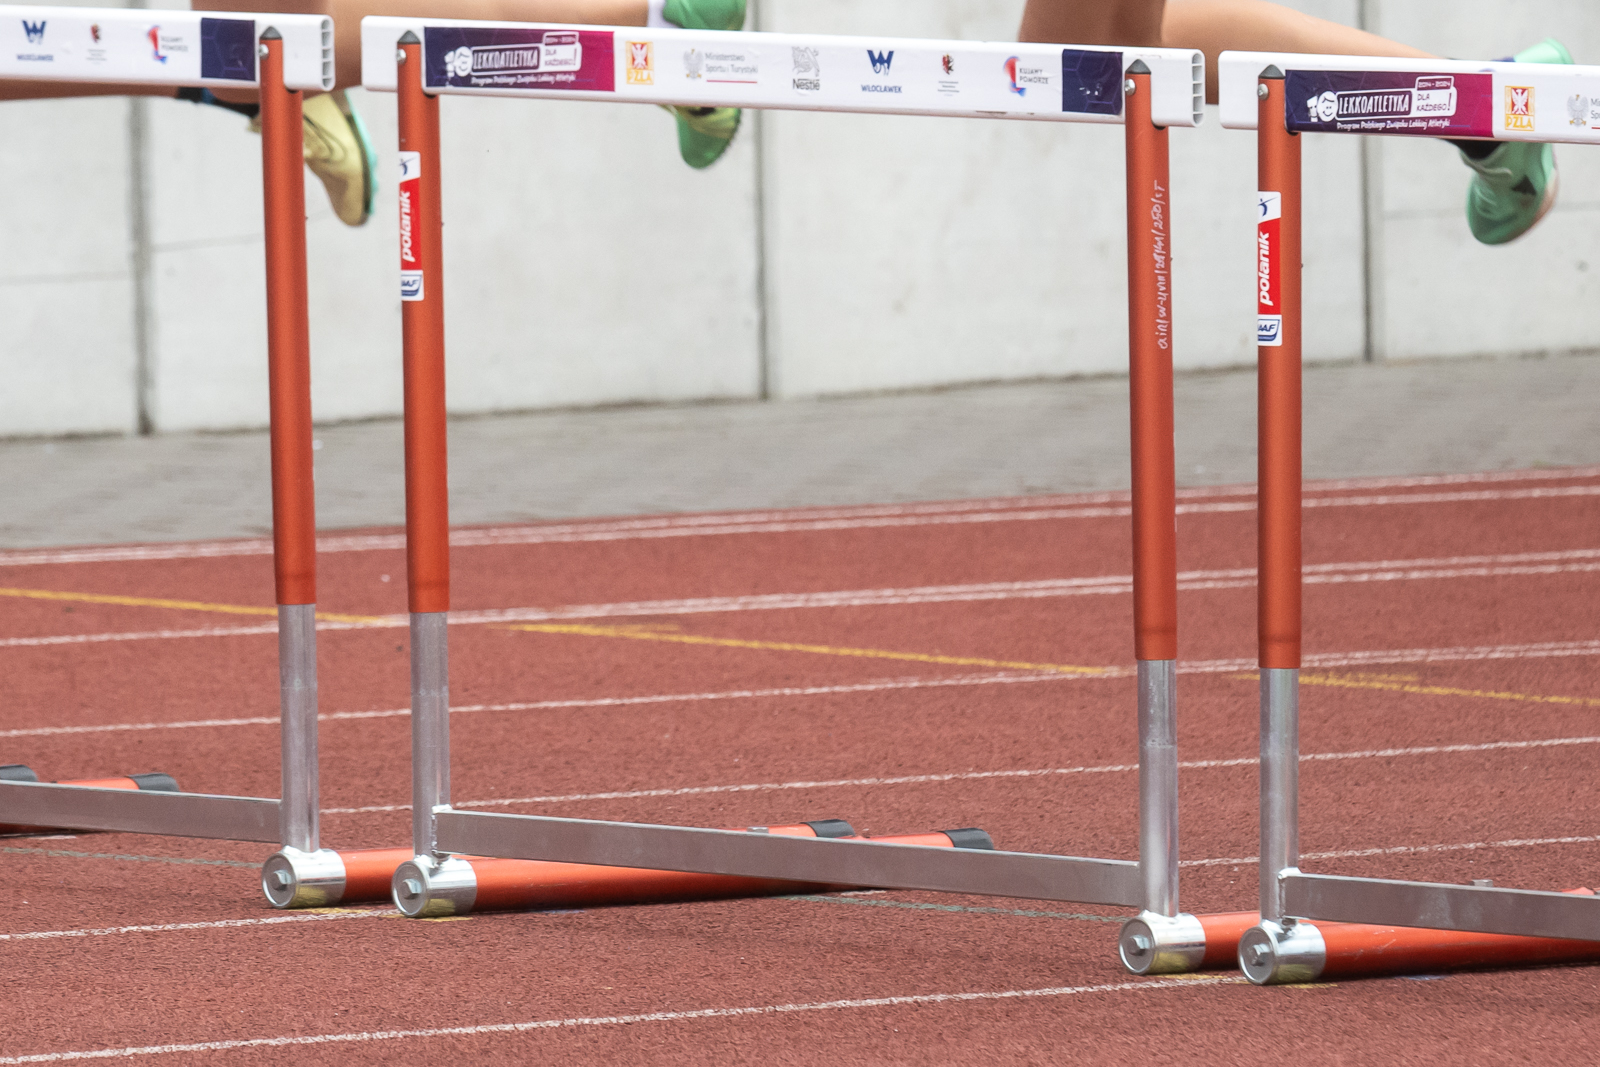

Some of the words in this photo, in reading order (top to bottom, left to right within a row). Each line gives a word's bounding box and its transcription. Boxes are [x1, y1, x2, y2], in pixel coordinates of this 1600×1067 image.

[473, 49, 538, 70] LEKKOATLETYKA
[1338, 94, 1410, 115] LEKKOATLETYKA
[1417, 93, 1431, 101] DLA
[1505, 115, 1533, 129] PZLA
[400, 191, 416, 263] polanik
[1258, 230, 1274, 307] polanik
